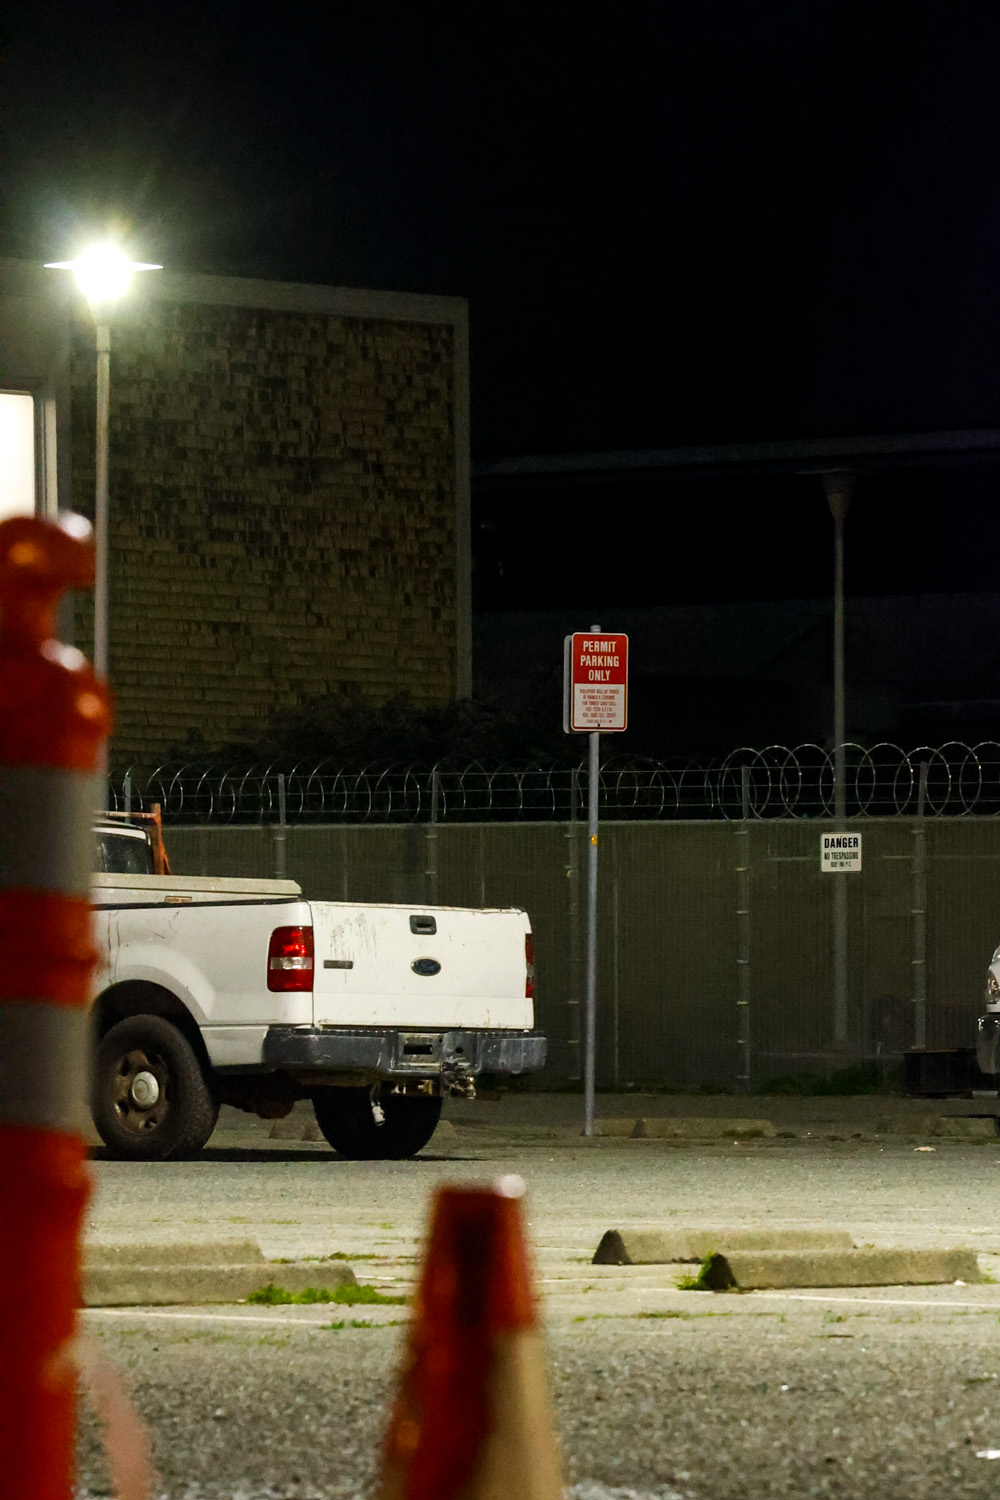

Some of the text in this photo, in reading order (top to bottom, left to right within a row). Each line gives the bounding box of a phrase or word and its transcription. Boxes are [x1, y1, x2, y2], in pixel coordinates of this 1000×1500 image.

[583, 641, 616, 652] PERMIT
[580, 655, 619, 666] PARKING
[588, 669, 611, 681] ONLY
[824, 838, 858, 848] DANGER
